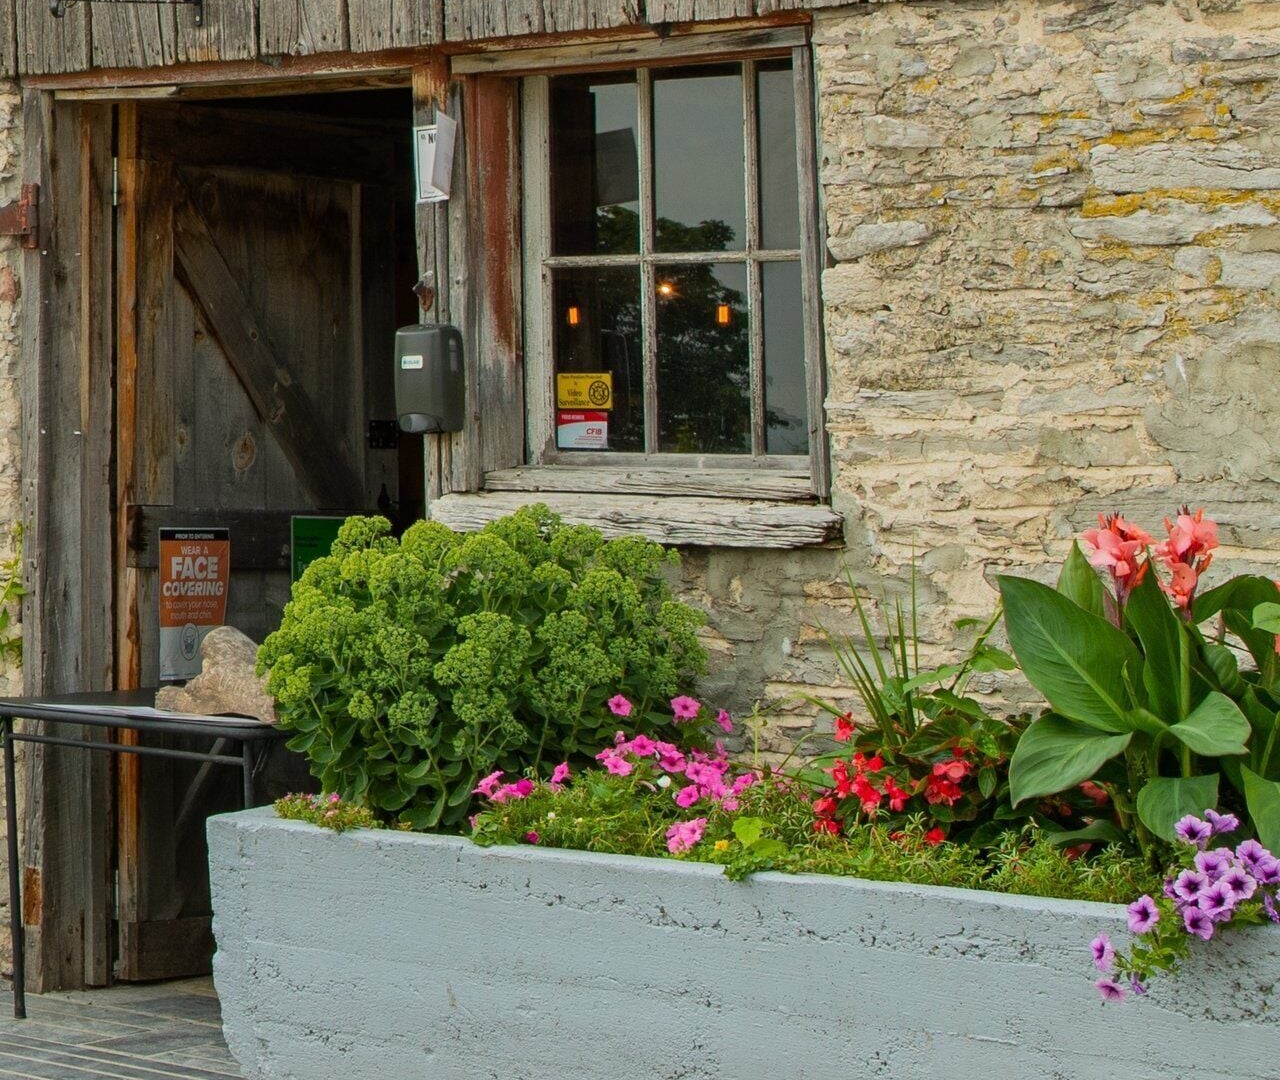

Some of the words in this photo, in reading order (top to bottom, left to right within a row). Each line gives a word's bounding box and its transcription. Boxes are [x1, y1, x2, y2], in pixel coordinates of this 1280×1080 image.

[181, 546, 201, 555] WEAR
[203, 546, 209, 555] A
[171, 556, 218, 580] FACE
[163, 581, 224, 597] COVERING
[166, 601, 173, 609] to
[189, 601, 201, 610] your
